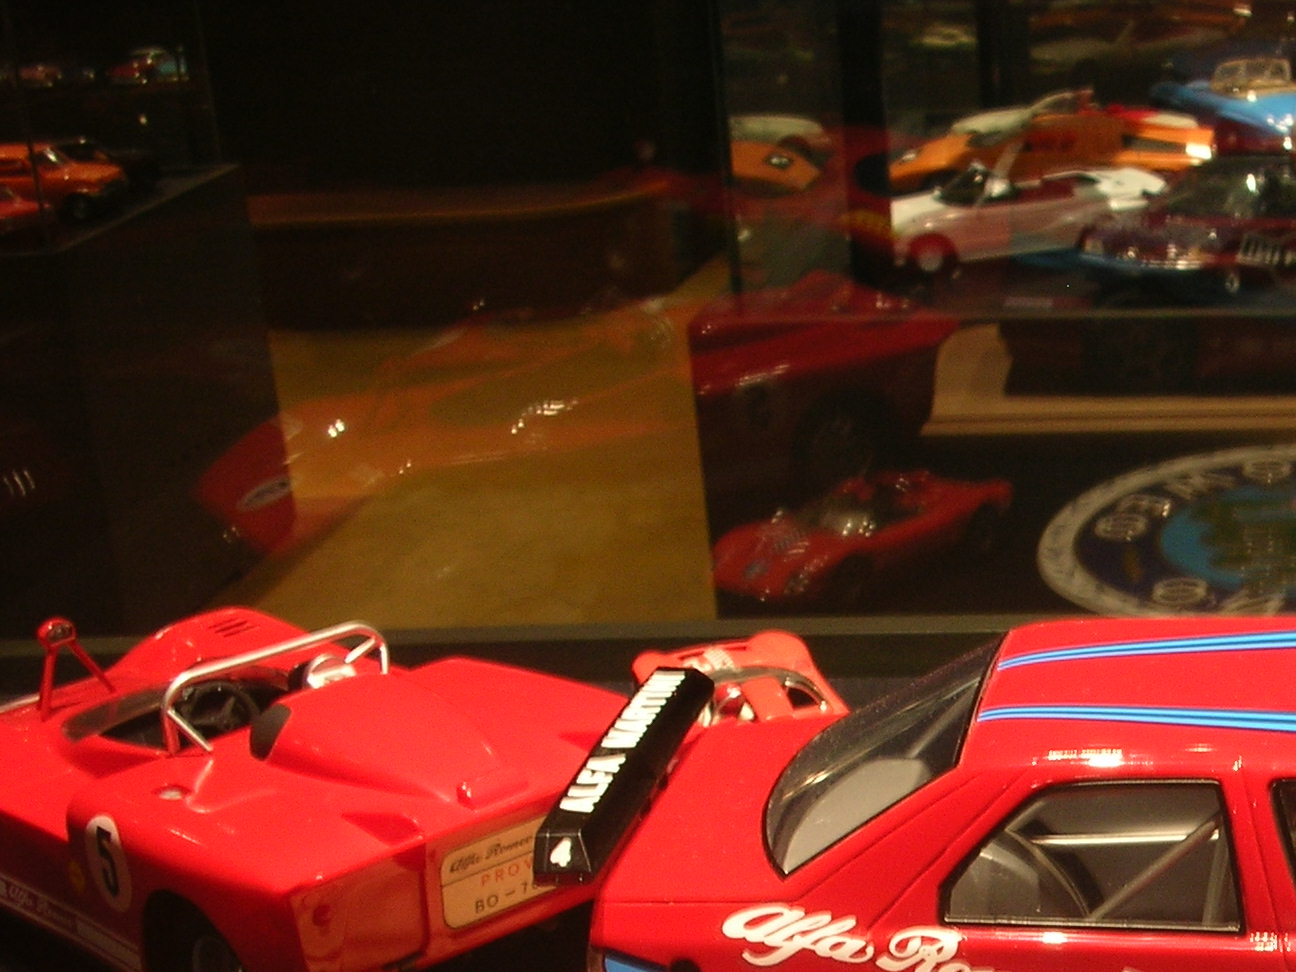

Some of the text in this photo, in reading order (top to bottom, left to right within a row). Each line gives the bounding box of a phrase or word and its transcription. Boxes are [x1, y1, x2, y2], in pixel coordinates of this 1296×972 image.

[559, 753, 627, 813] ALFA
[96, 825, 119, 896] 5
[722, 902, 873, 966] Alfa
